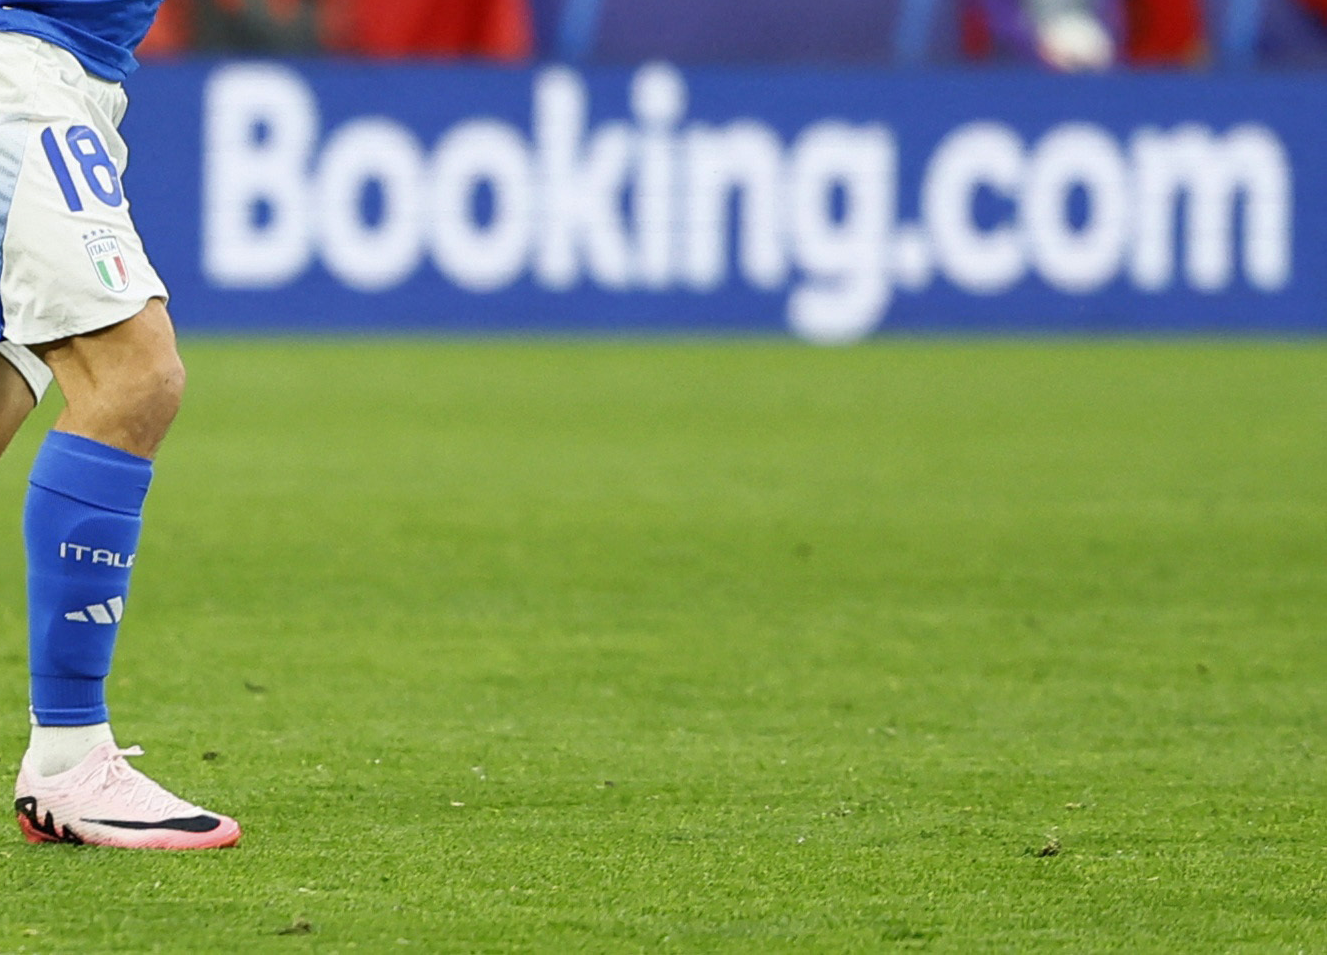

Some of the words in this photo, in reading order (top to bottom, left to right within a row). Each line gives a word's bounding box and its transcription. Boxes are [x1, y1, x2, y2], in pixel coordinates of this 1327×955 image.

[40, 125, 123, 212] 18
[201, 62, 1292, 345] Booking.com
[89, 241, 117, 257] ITALIA
